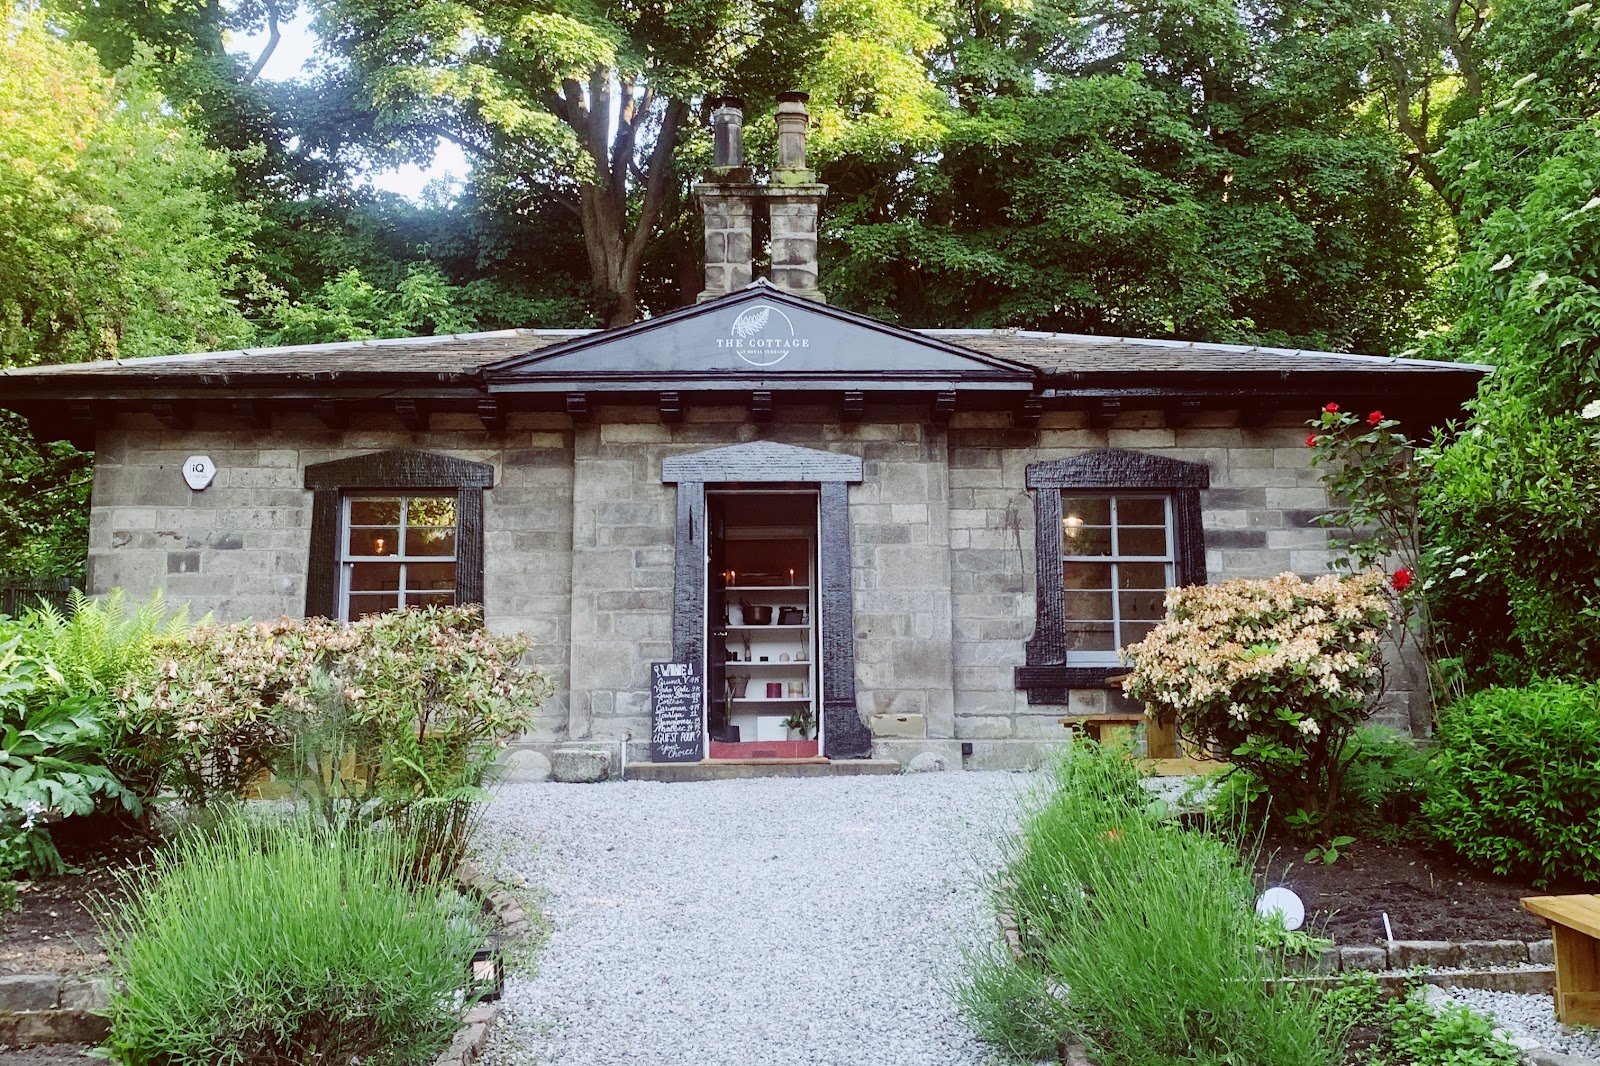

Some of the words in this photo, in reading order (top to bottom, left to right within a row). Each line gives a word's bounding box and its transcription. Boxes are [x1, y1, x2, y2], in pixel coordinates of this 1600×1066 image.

[716, 339, 743, 348] THE
[748, 339, 810, 348] COTTAGE
[192, 463, 204, 473] iQ
[660, 664, 687, 676] WINE
